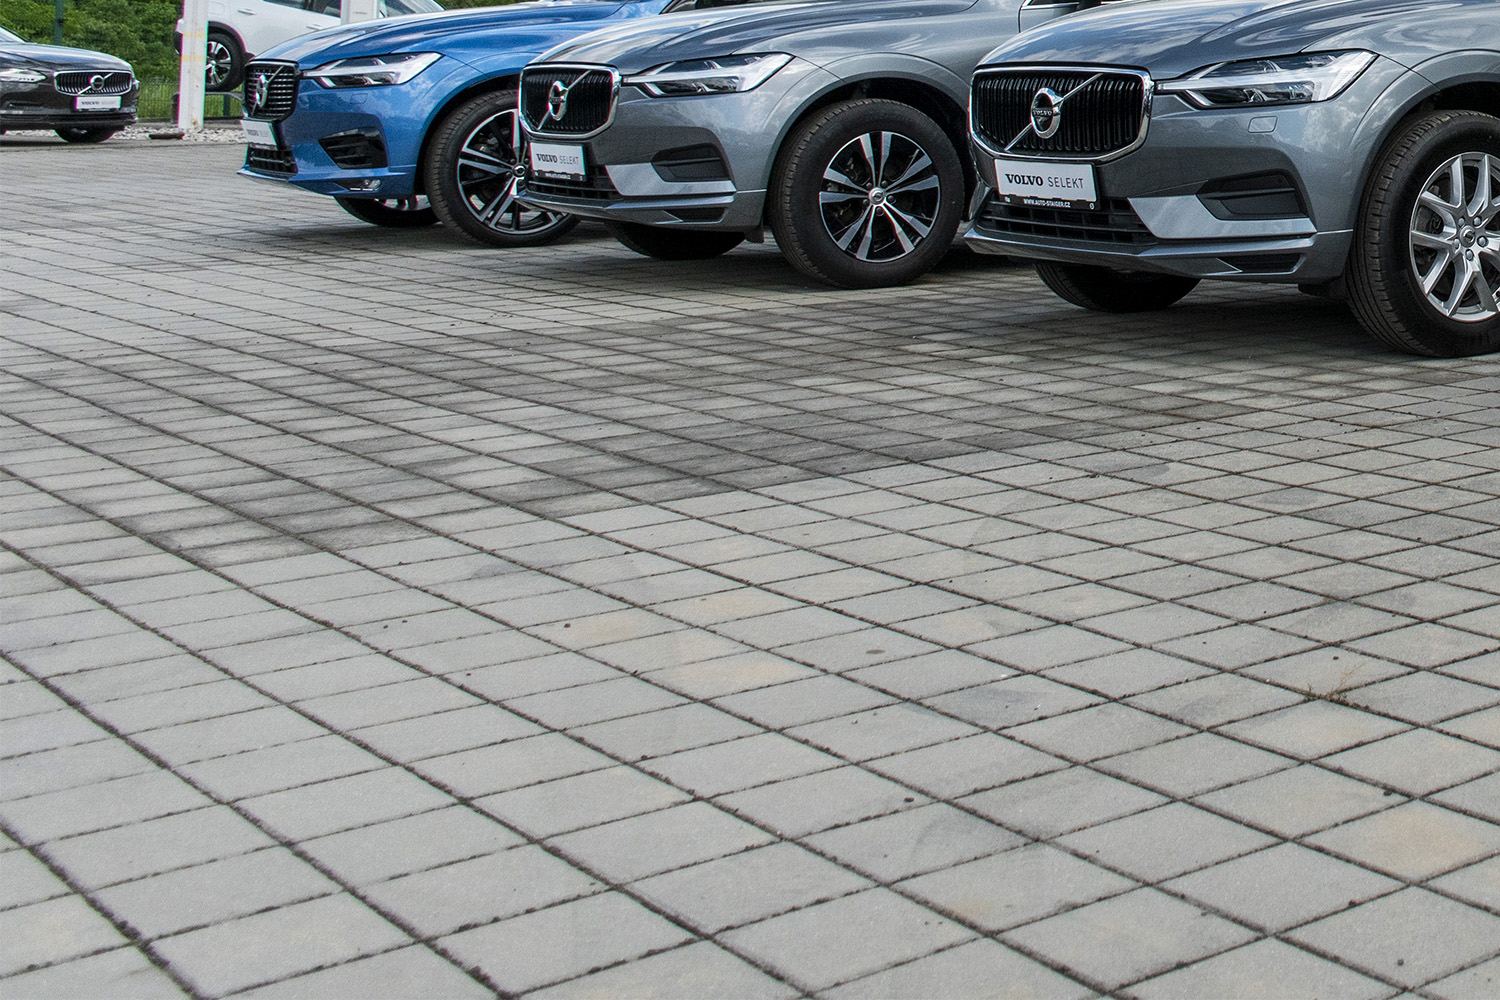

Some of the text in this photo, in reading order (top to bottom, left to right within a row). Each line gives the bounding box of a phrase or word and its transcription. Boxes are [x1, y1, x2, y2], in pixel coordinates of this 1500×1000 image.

[536, 153, 558, 163] VOLVO
[1005, 173, 1084, 189] VOLVO SELEKT
